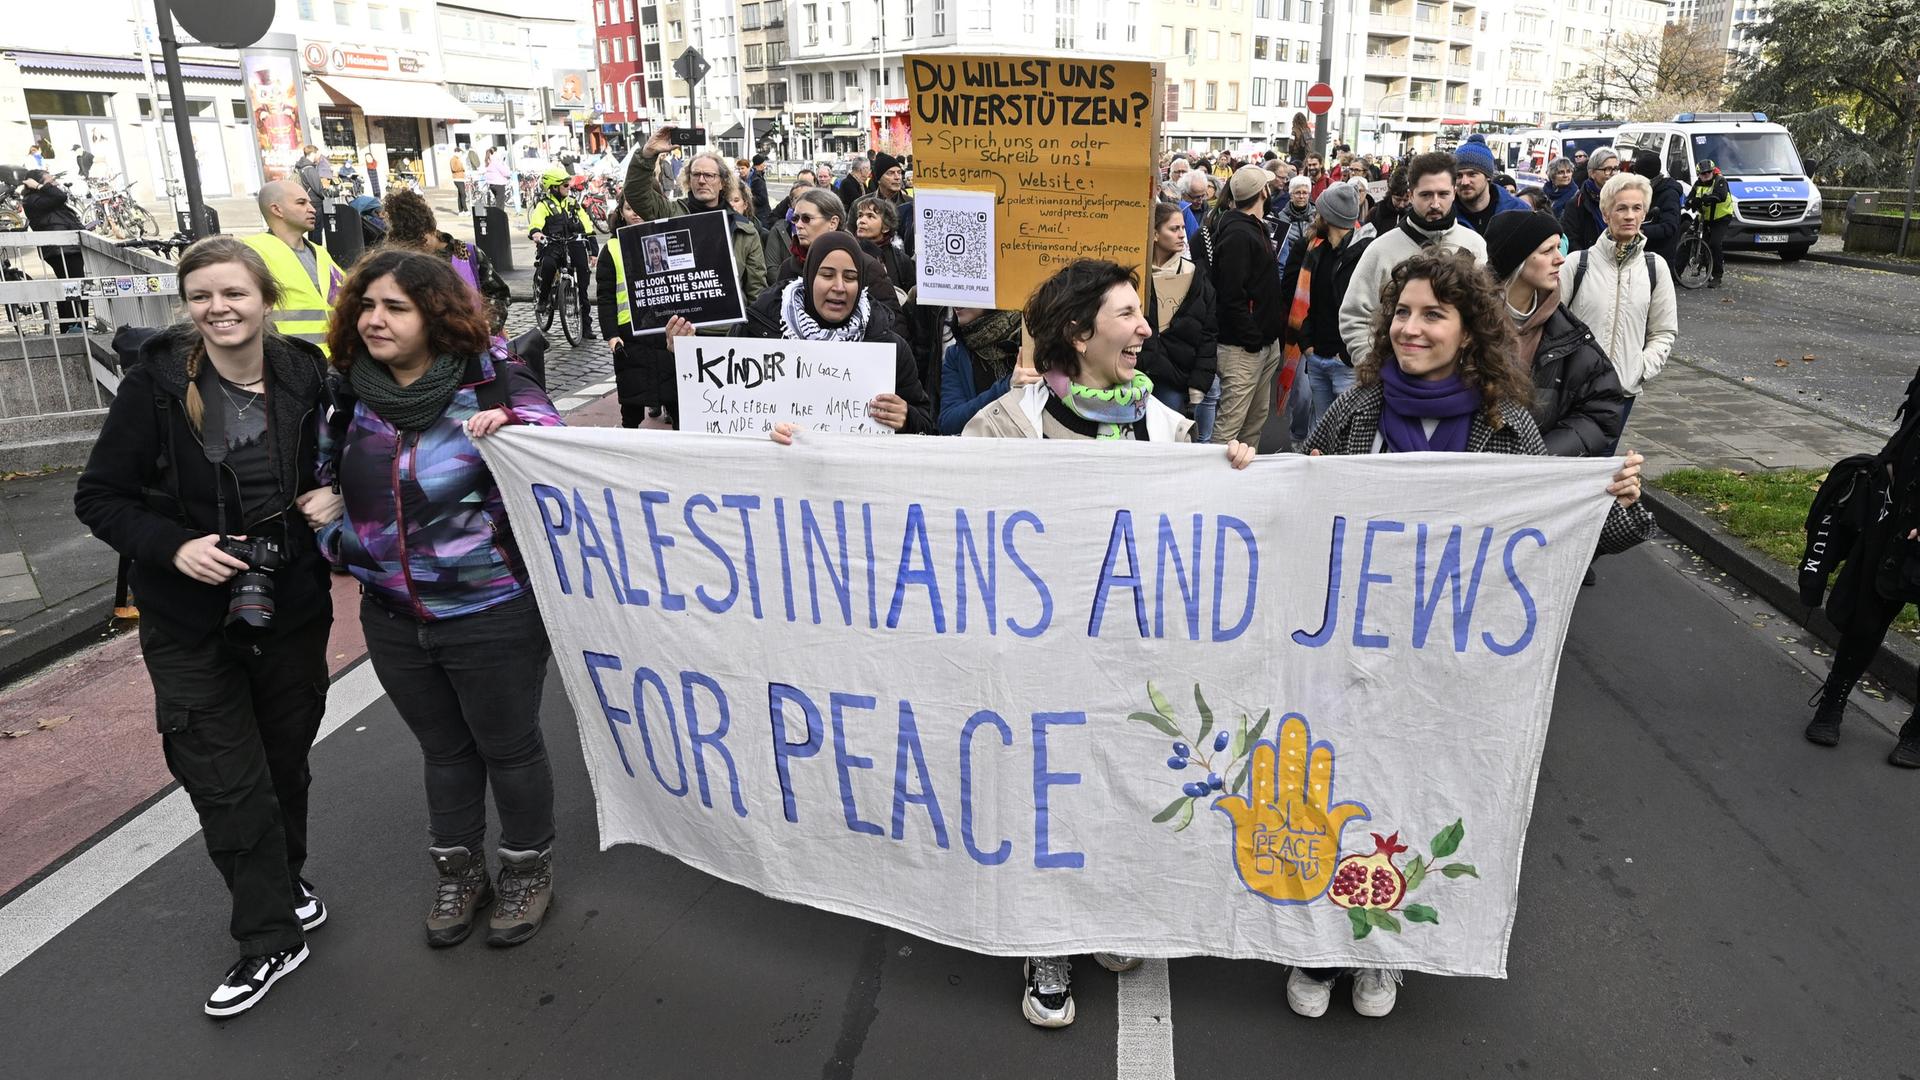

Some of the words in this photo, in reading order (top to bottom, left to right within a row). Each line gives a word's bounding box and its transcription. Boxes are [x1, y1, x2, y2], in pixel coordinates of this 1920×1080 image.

[912, 60, 955, 91] DU
[962, 61, 1051, 88] WILLST
[1058, 63, 1115, 90] UNS
[917, 91, 1149, 128] UNTERSTÜTZEN?
[938, 130, 996, 153] Sprich
[1004, 138, 1033, 149] uns
[1038, 138, 1059, 149] an
[1071, 132, 1109, 149] oder
[1051, 151, 1091, 167] uns!
[916, 160, 992, 182] Instagram
[1019, 172, 1094, 191] Website:
[1040, 209, 1109, 221] wordpress.com
[1000, 238, 1140, 258] palestiniansandjewsforpeace
[634, 280, 645, 289] WE
[646, 276, 666, 287] LOOK
[667, 273, 686, 283] THE
[687, 269, 719, 280] SAME.
[635, 290, 645, 298] WE
[646, 286, 669, 297] BLEED
[671, 283, 689, 293] THE
[691, 279, 723, 290] SAME.
[636, 299, 646, 308] WE
[647, 294, 682, 306] DESERVE
[683, 288, 726, 300] BETTER.
[531, 483, 1054, 638] PALESTINIANS
[1087, 509, 1259, 642] AND
[1290, 515, 1547, 657] JEWS
[583, 650, 748, 818] FOR
[768, 682, 1086, 869] PEACE
[1256, 834, 1321, 860] PEACE
